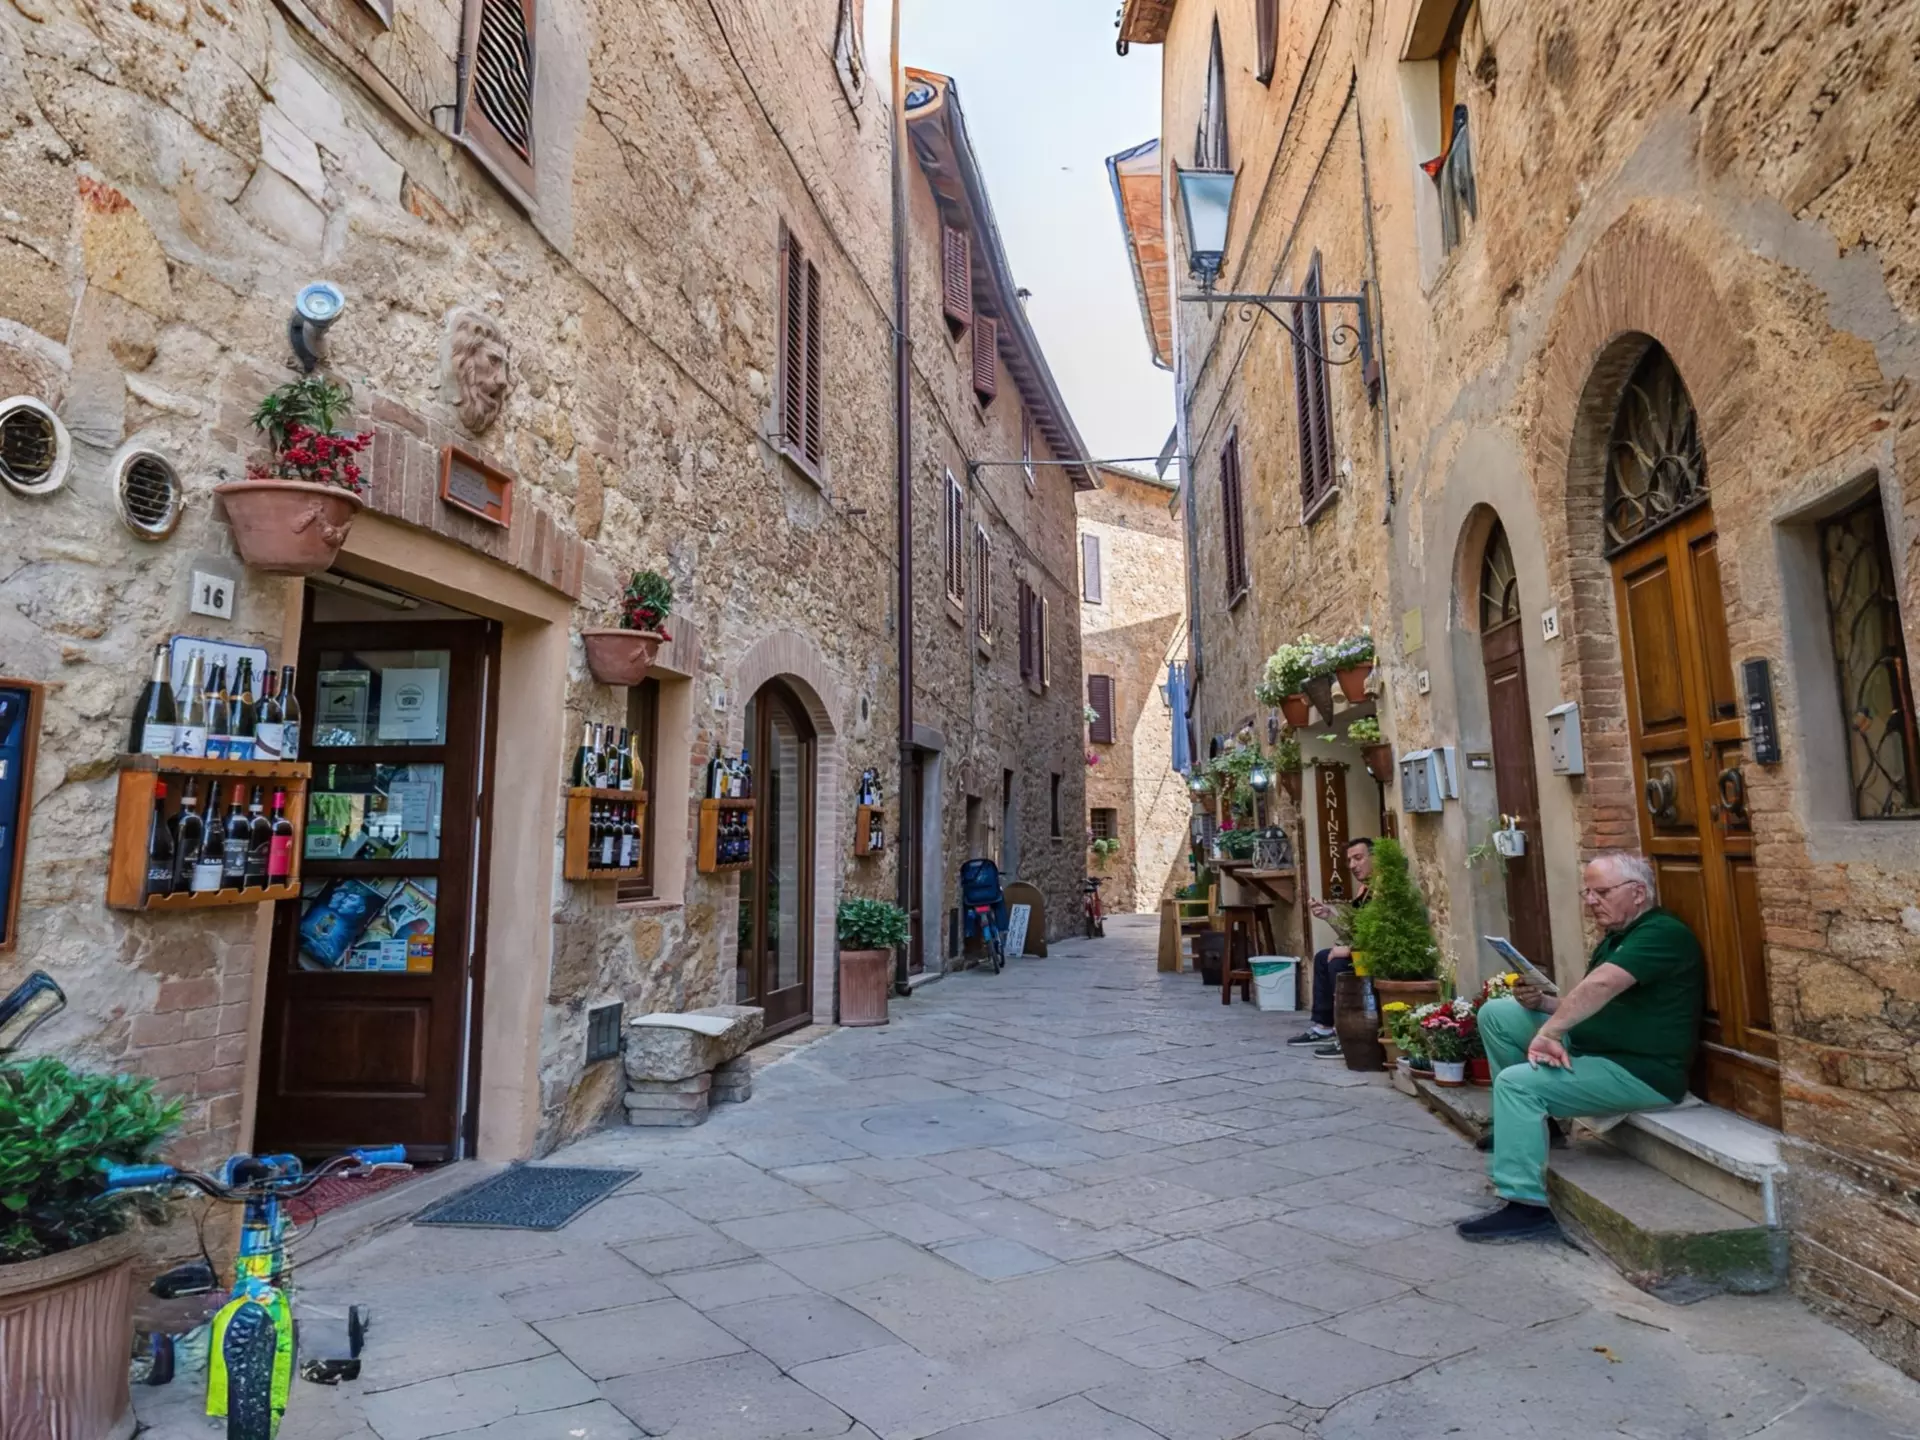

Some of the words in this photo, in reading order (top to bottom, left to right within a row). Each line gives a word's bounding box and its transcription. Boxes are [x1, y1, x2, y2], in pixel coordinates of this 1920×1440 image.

[203, 584, 225, 610] 16
[1543, 617, 1554, 633] 15
[1324, 771, 1343, 883] PANINERIA
